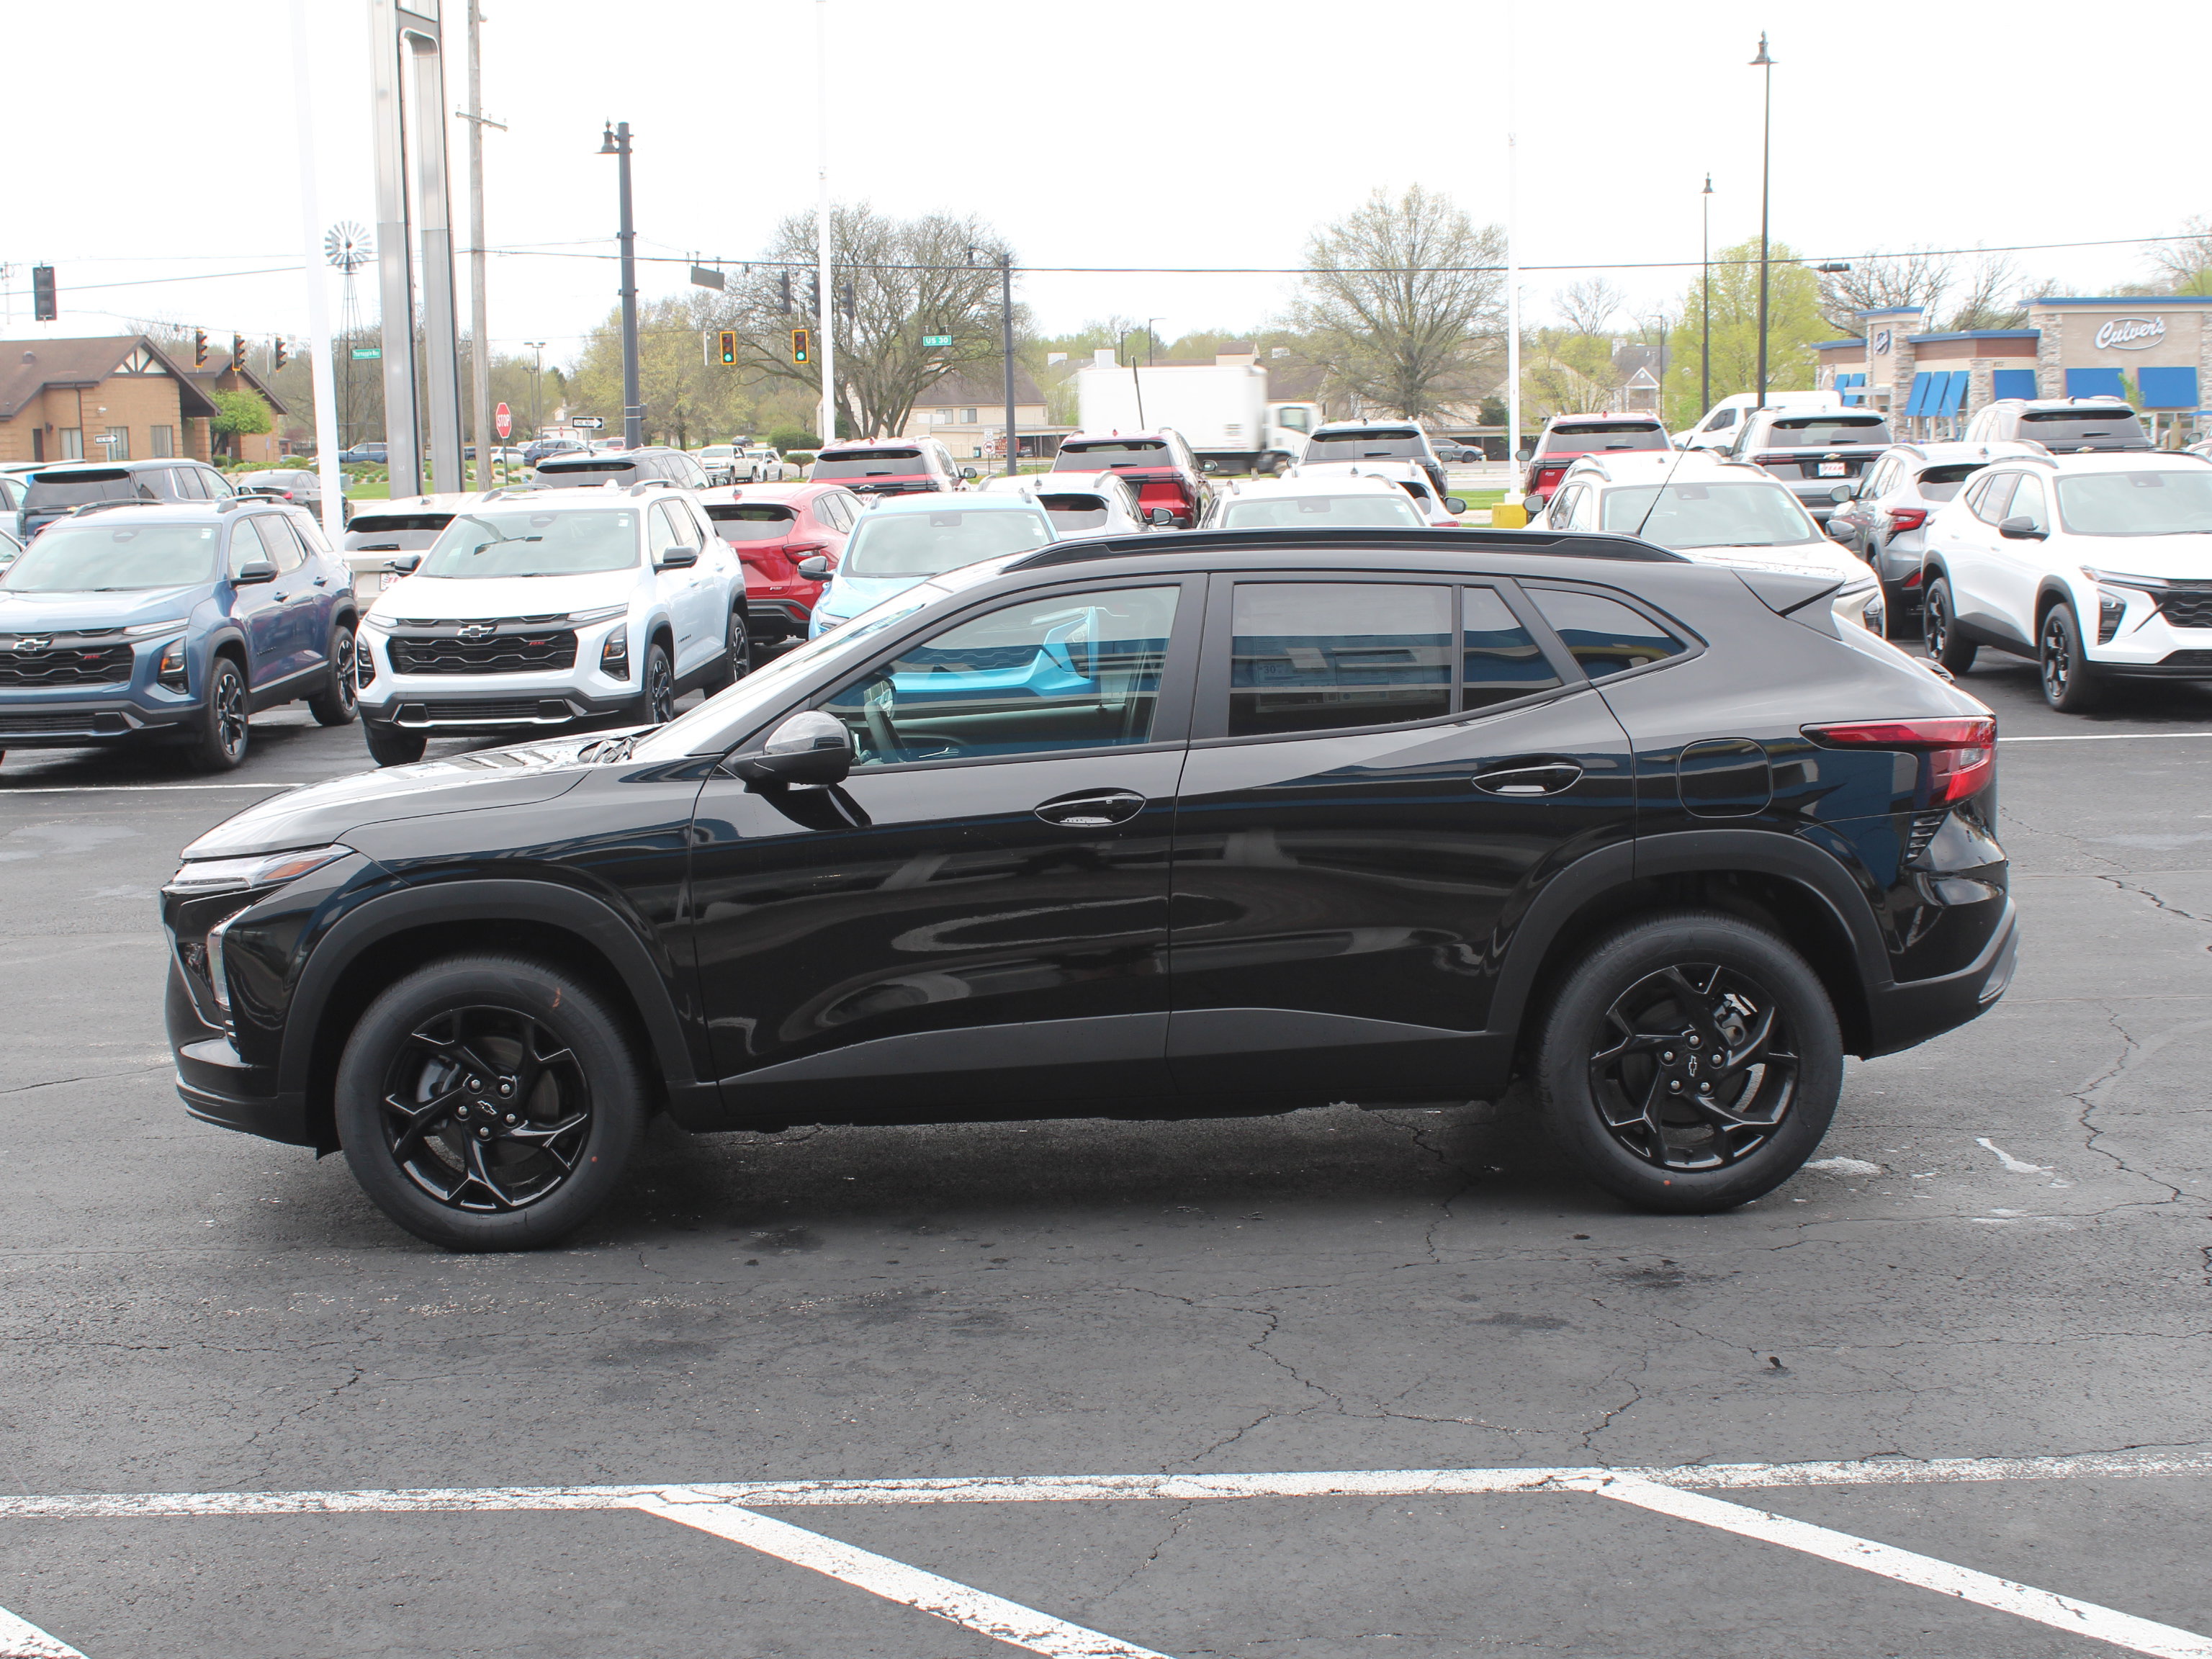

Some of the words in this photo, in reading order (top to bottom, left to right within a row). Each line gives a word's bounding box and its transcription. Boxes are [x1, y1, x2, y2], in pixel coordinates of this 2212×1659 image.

[2095, 316, 2167, 349] Culver's
[497, 414, 510, 427] STOP
[1263, 665, 1276, 674] 30
